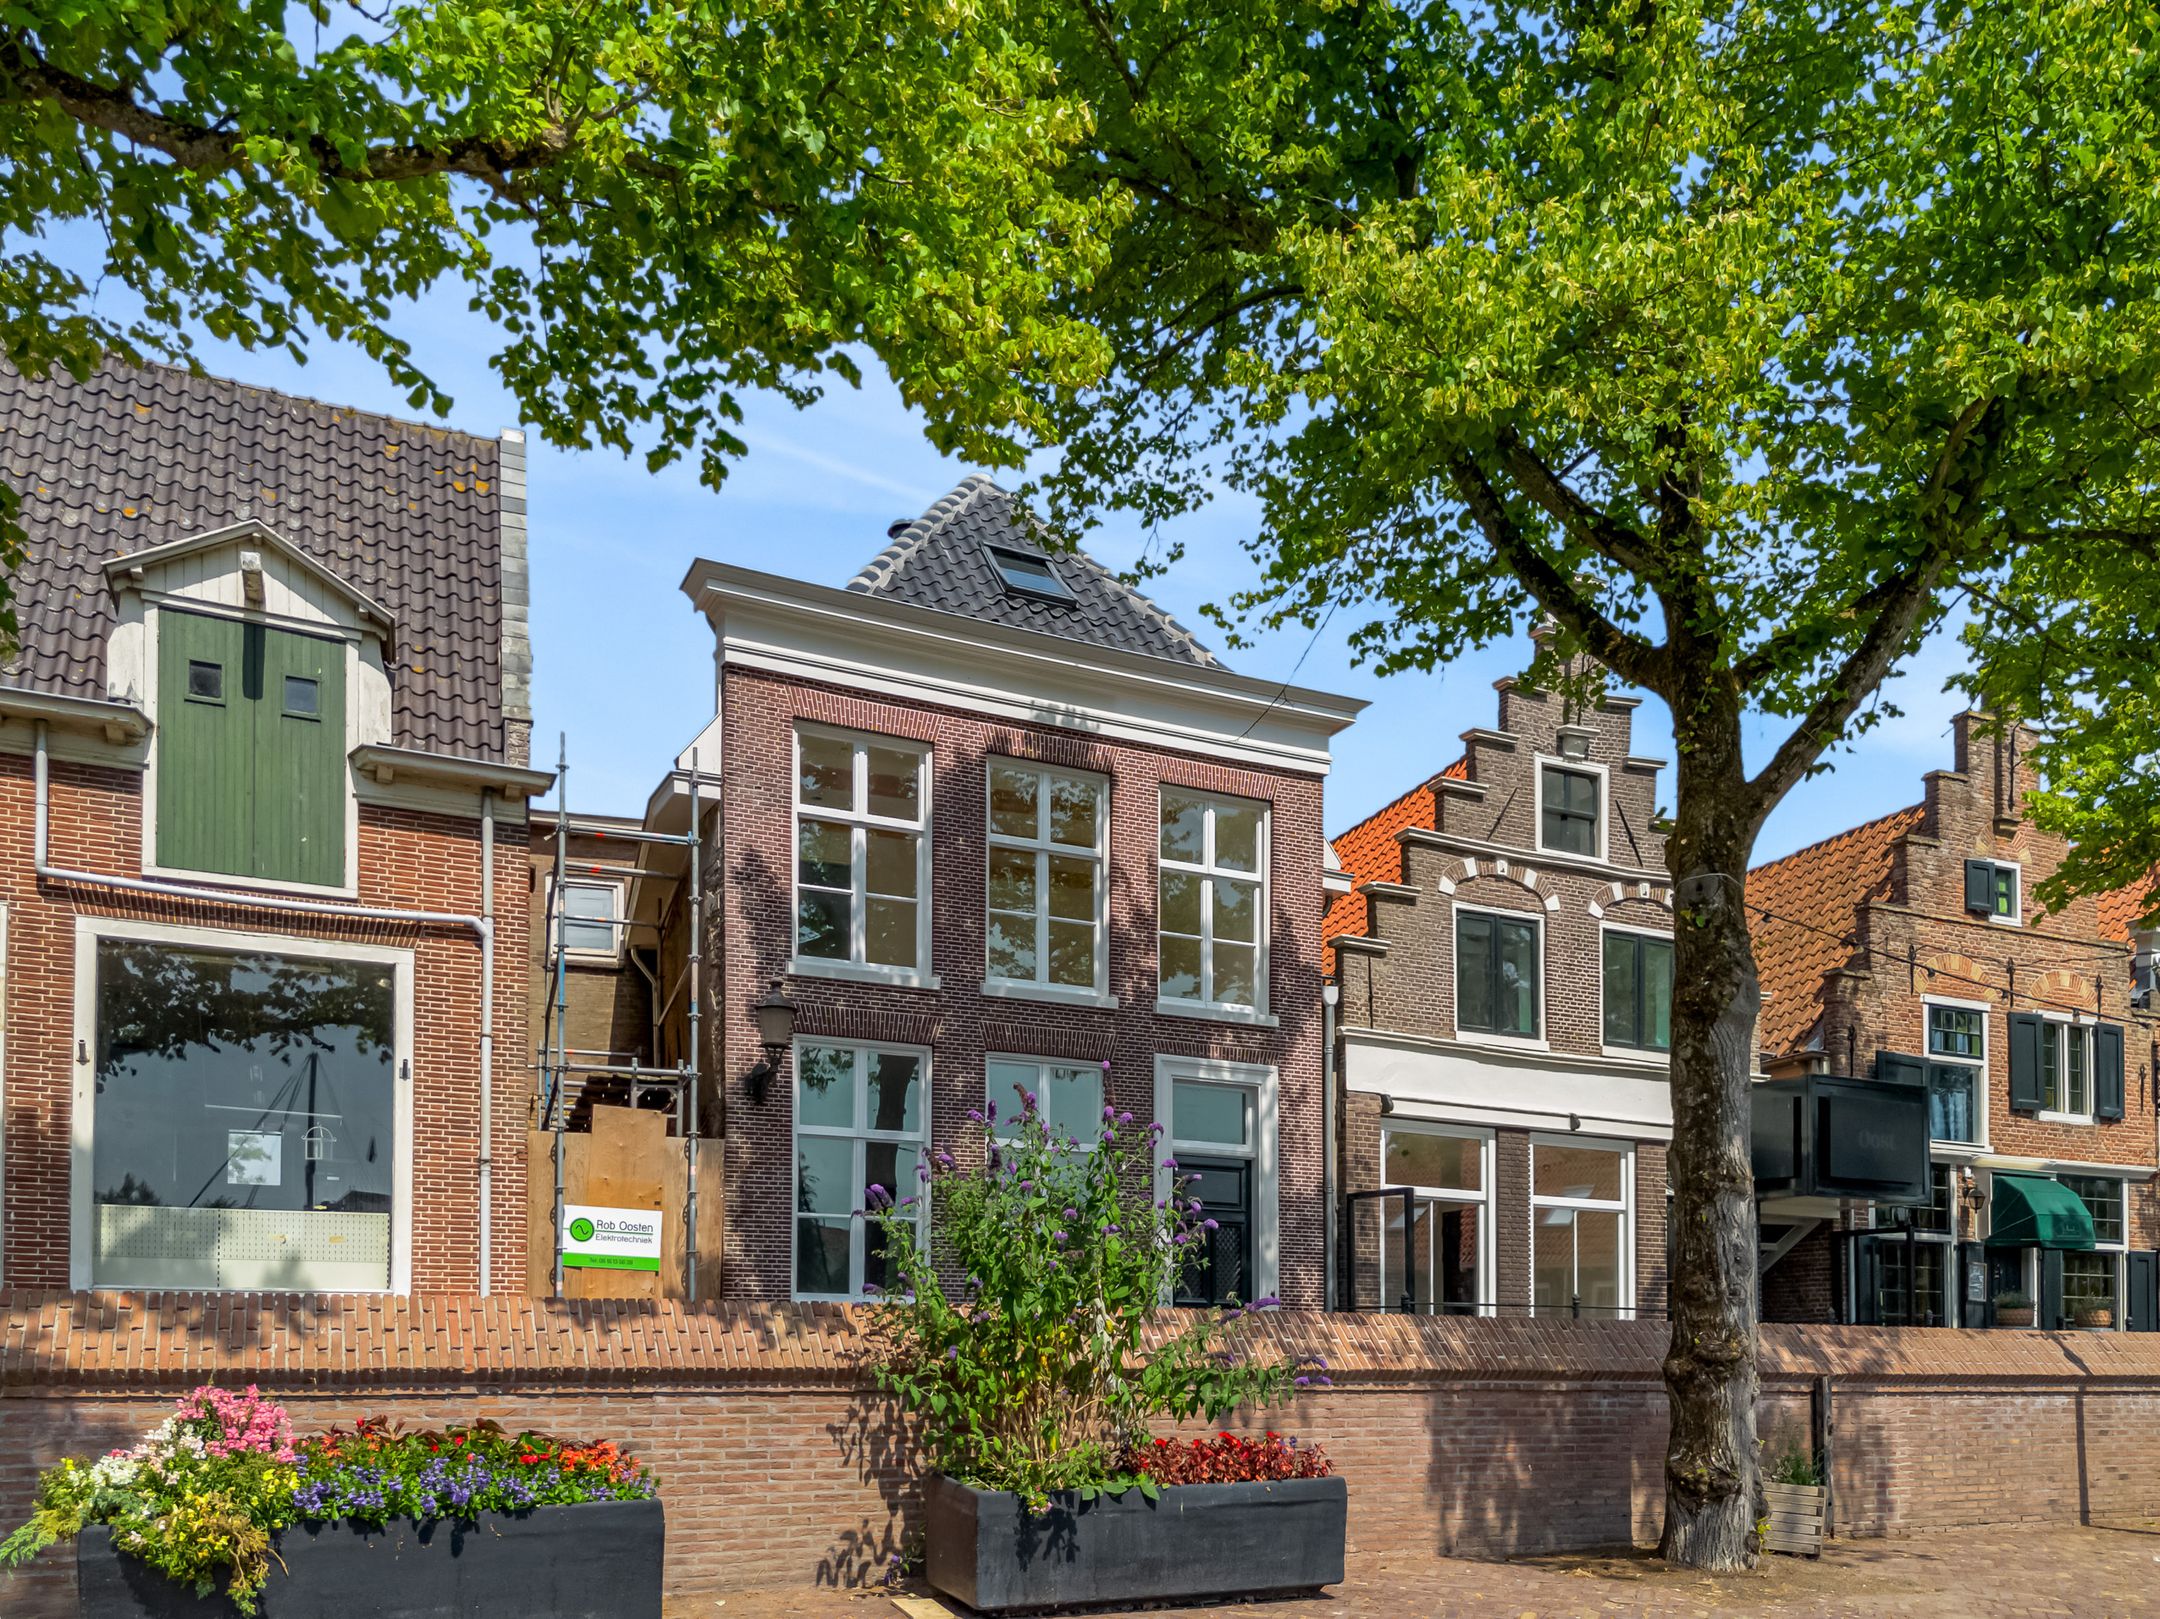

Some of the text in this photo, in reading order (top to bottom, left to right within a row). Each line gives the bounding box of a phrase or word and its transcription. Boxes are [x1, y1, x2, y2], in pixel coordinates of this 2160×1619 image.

[596, 1219, 653, 1232] Rob Oosten
[595, 1233, 653, 1244] Elektrotechniek
